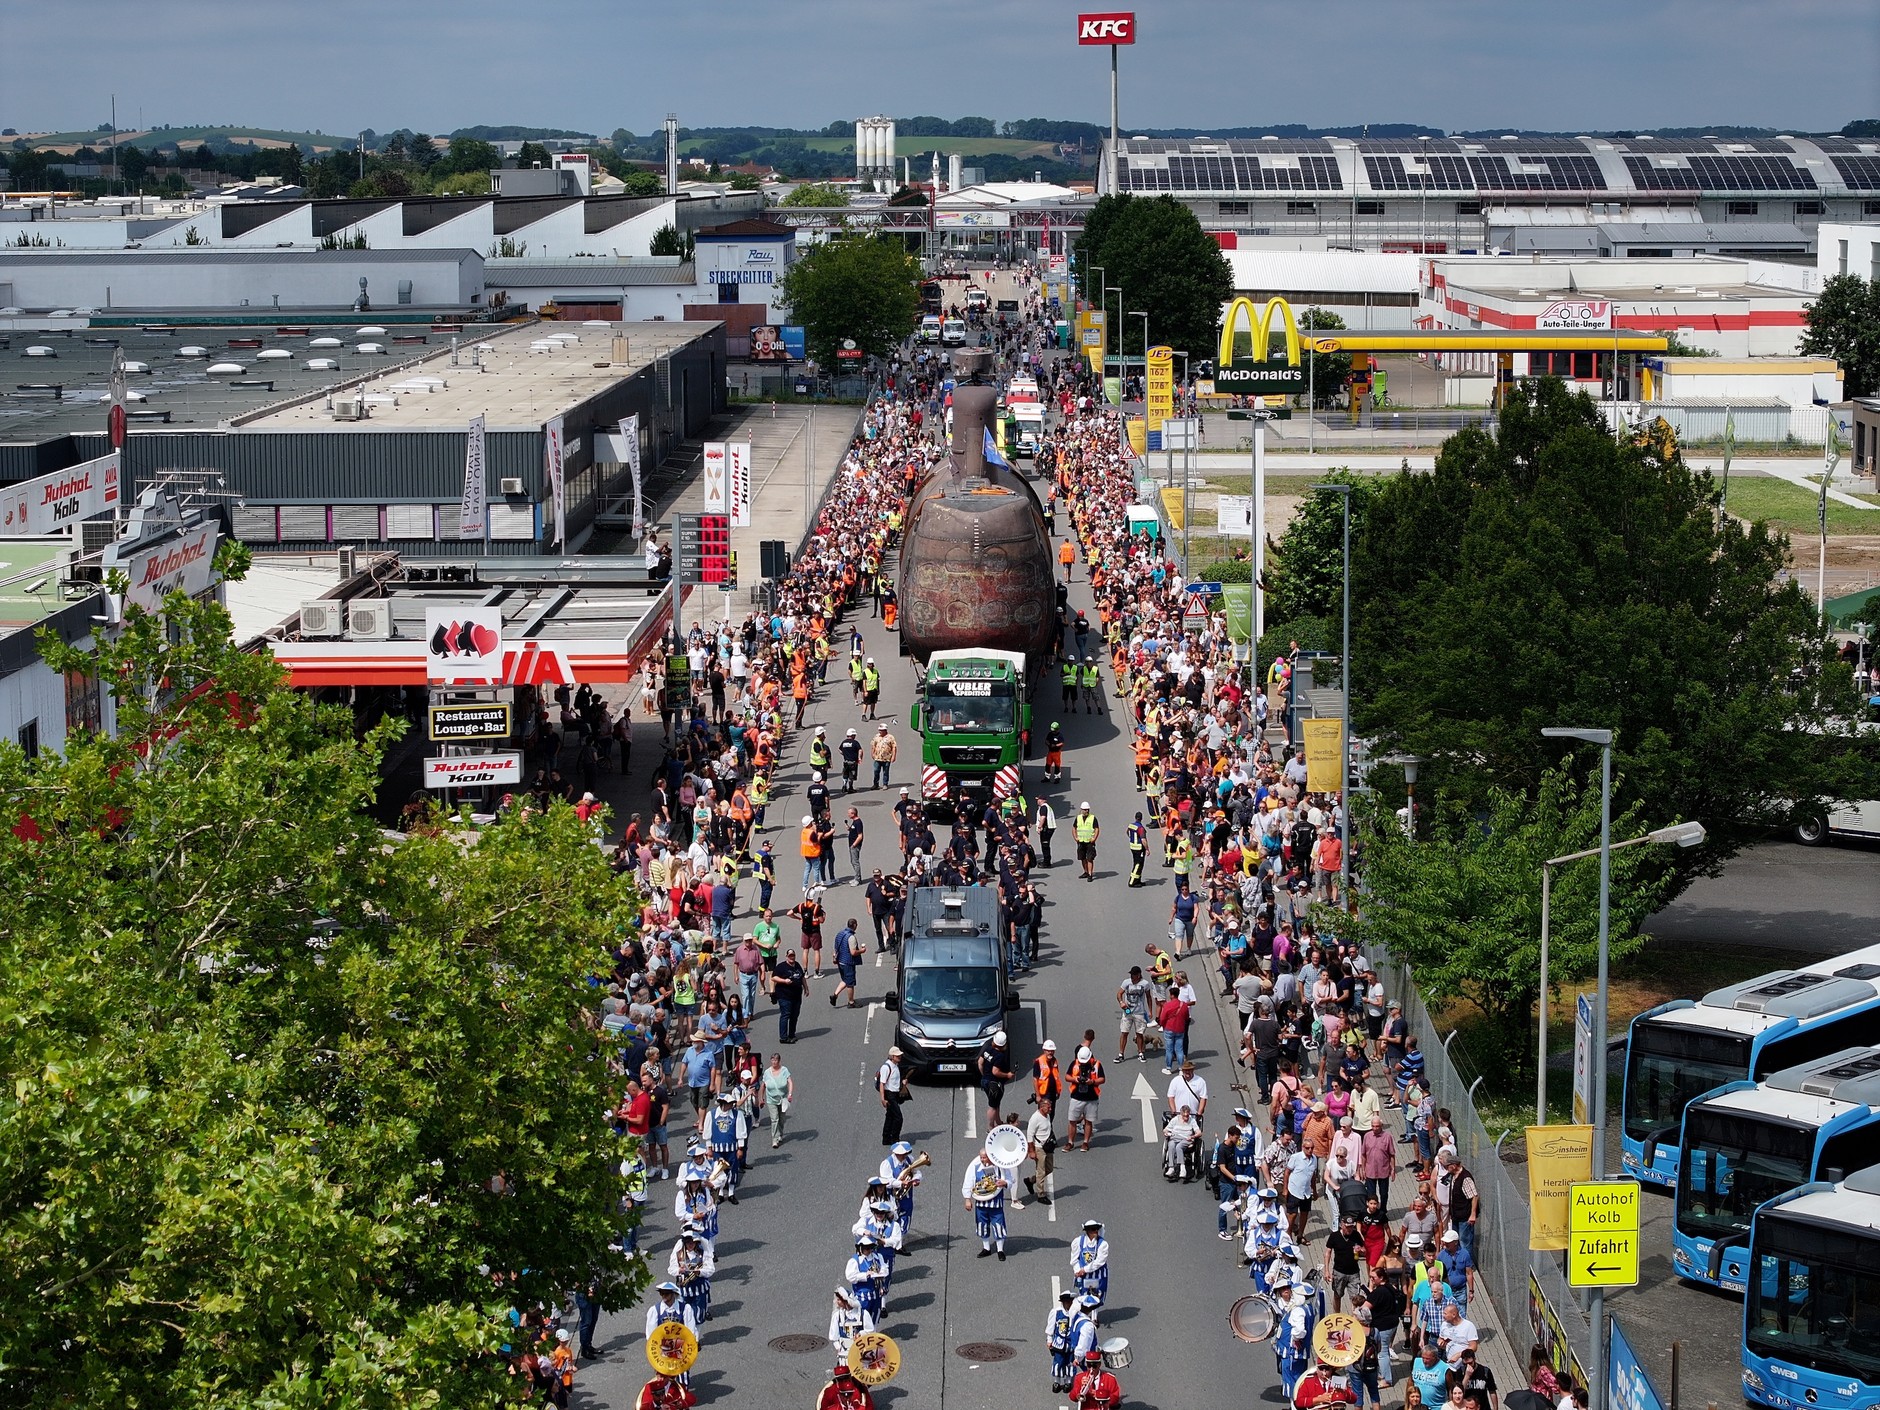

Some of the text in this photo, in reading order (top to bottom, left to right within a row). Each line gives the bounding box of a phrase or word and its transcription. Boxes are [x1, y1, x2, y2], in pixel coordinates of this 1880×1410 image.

[1080, 20, 1128, 38] KFC
[709, 270, 773, 284] STRECKGITTER
[1543, 320, 1606, 329] Auto-Teile-Unger
[1319, 342, 1337, 350] JET
[1149, 349, 1170, 358] JET
[1218, 370, 1302, 381] McDonald's
[105, 464, 118, 486] AVIA
[41, 472, 93, 506] Autohof
[732, 447, 740, 525] Autohof
[53, 497, 80, 522] Kolb
[137, 532, 208, 588] Autohof
[435, 709, 504, 722] Restaurant
[428, 759, 518, 773] Autohof
[448, 773, 496, 783] Kolb
[1576, 1192, 1635, 1206] Autohof
[1588, 1210, 1621, 1224] Kolb
[1579, 1239, 1629, 1255] Zufahrt
[664, 1324, 682, 1336] SFZ
[1323, 1316, 1354, 1330] SFZ
[855, 1335, 886, 1351] SFZ
[1318, 1344, 1362, 1364] Waibsadt
[852, 1361, 897, 1384] Waibstadt
[1770, 1365, 1798, 1380] SWEG
[1837, 1387, 1853, 1396] VRN
